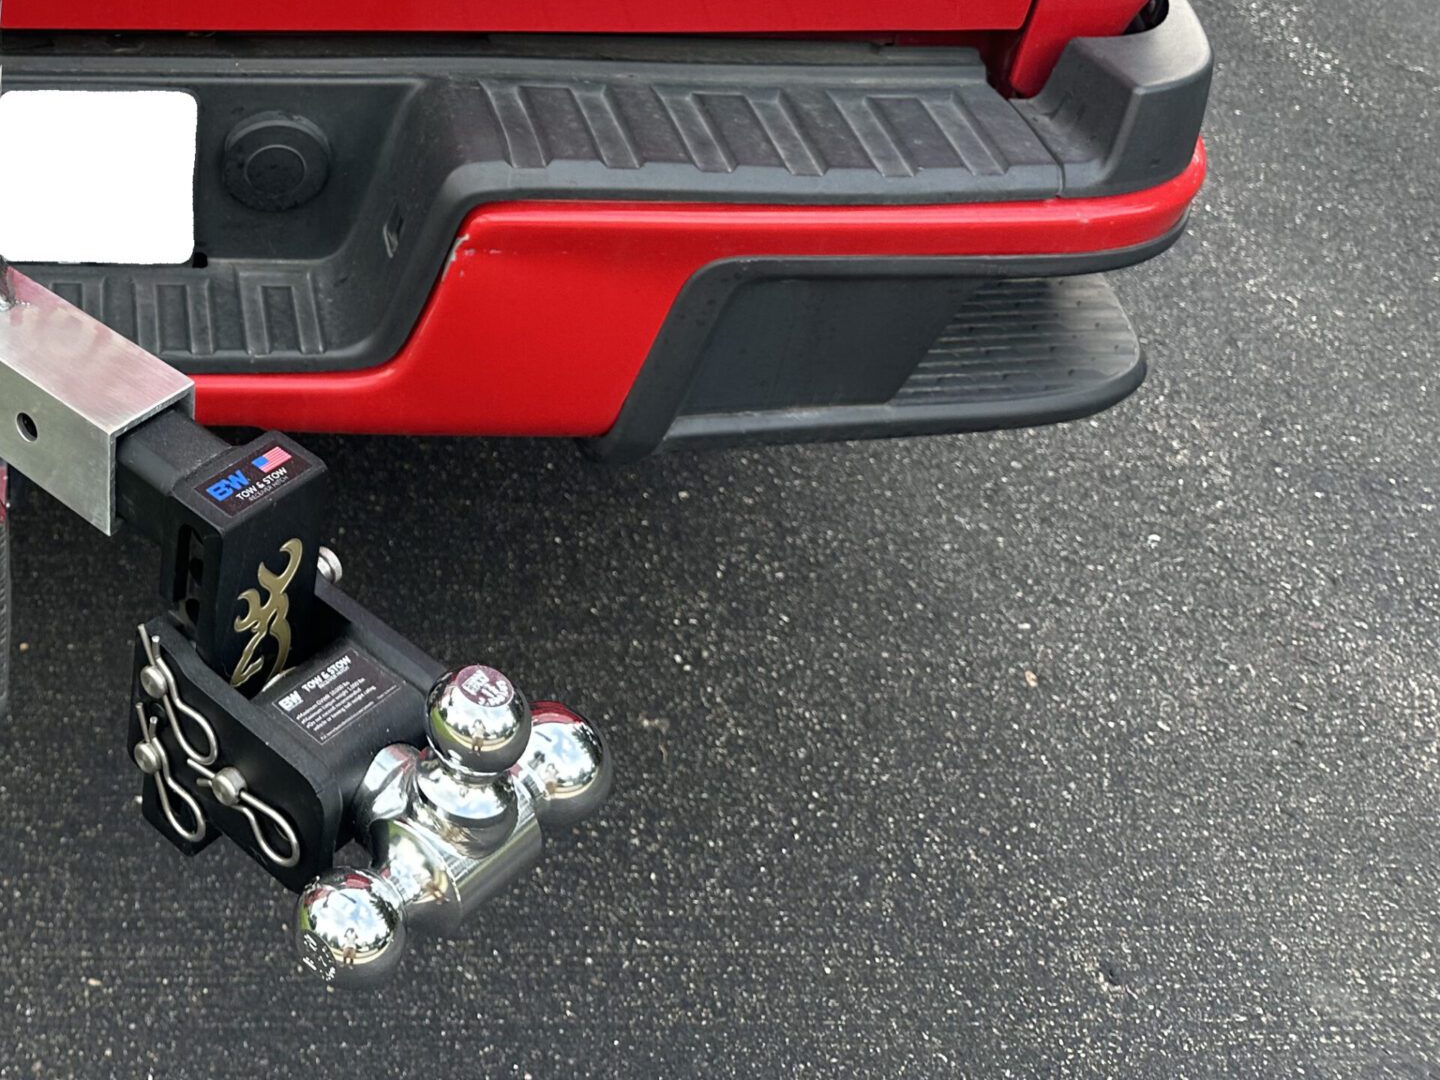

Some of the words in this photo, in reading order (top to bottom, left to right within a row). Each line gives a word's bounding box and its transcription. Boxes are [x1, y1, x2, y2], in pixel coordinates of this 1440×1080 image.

[236, 484, 258, 500] TOW
[256, 481, 265, 489] &
[262, 466, 288, 485] STOW
[301, 674, 323, 693] TOW
[321, 671, 330, 680] &
[327, 655, 352, 675] STOW
